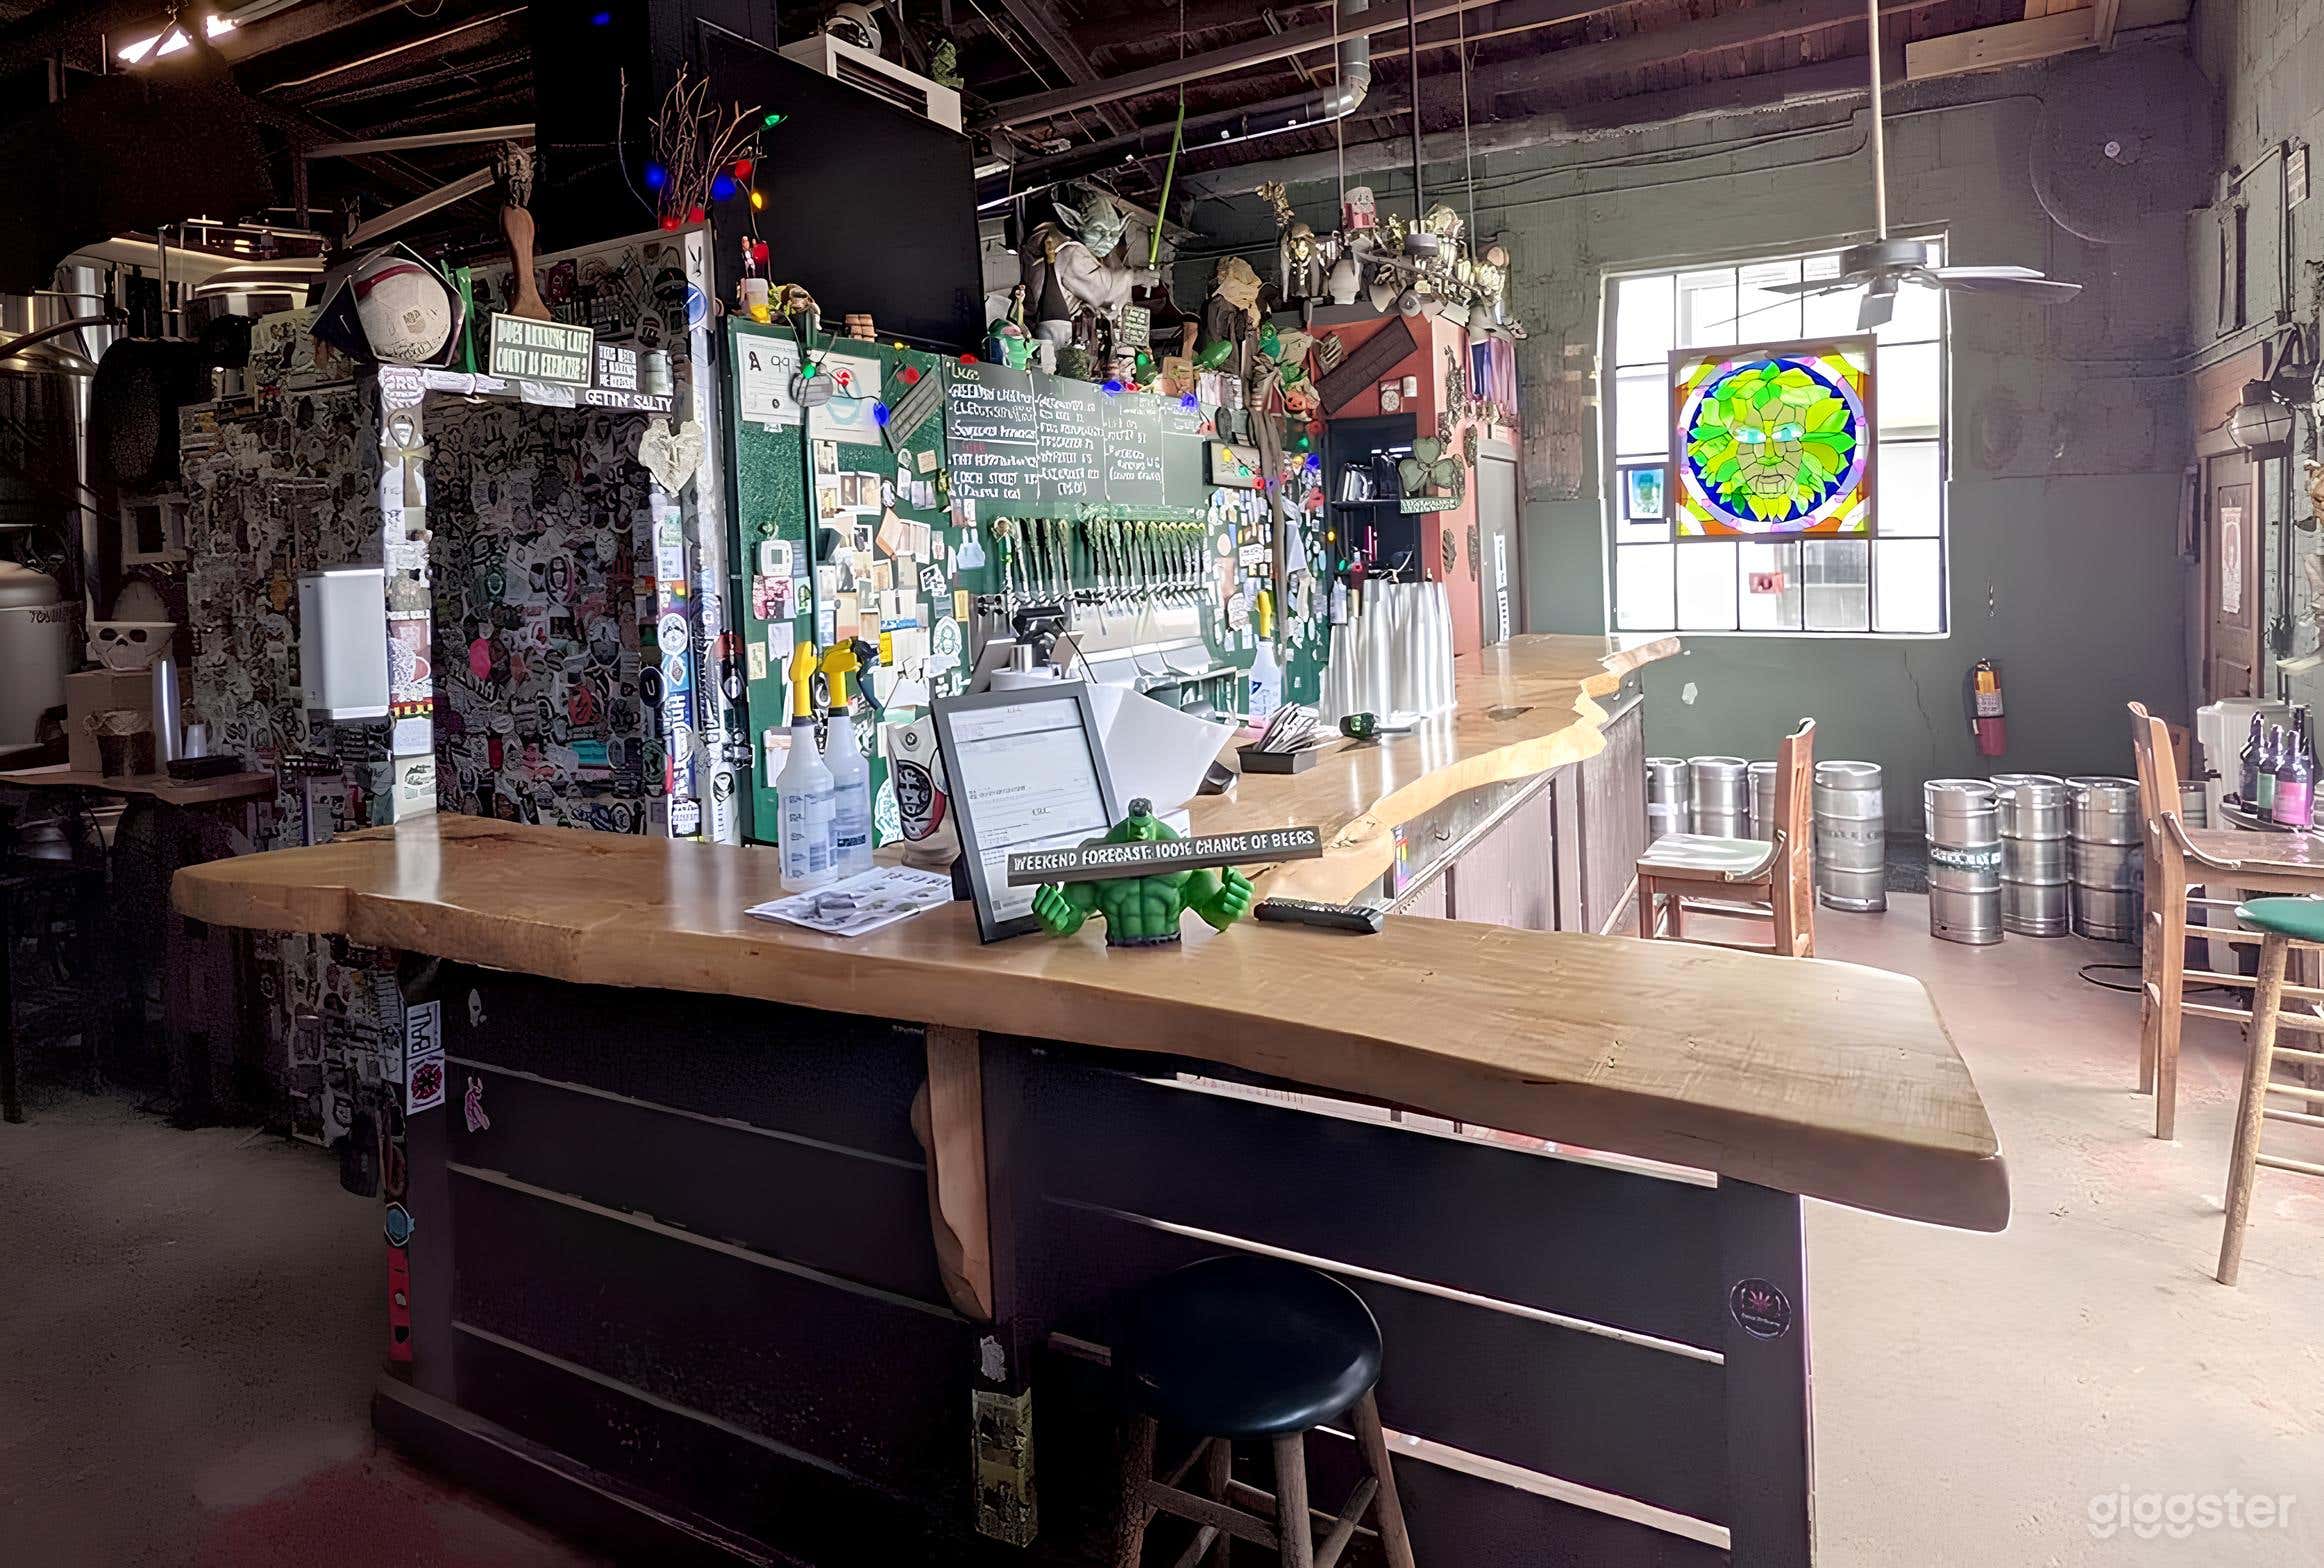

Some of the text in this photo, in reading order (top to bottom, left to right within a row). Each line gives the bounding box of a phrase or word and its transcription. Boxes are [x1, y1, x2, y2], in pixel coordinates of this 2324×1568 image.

[633, 394, 673, 412] SALTY
[1013, 854, 1078, 871] WEEKEND
[1196, 836, 1248, 855] CHANCE
[1251, 832, 1270, 849] OF
[1271, 830, 1316, 847] BEERS
